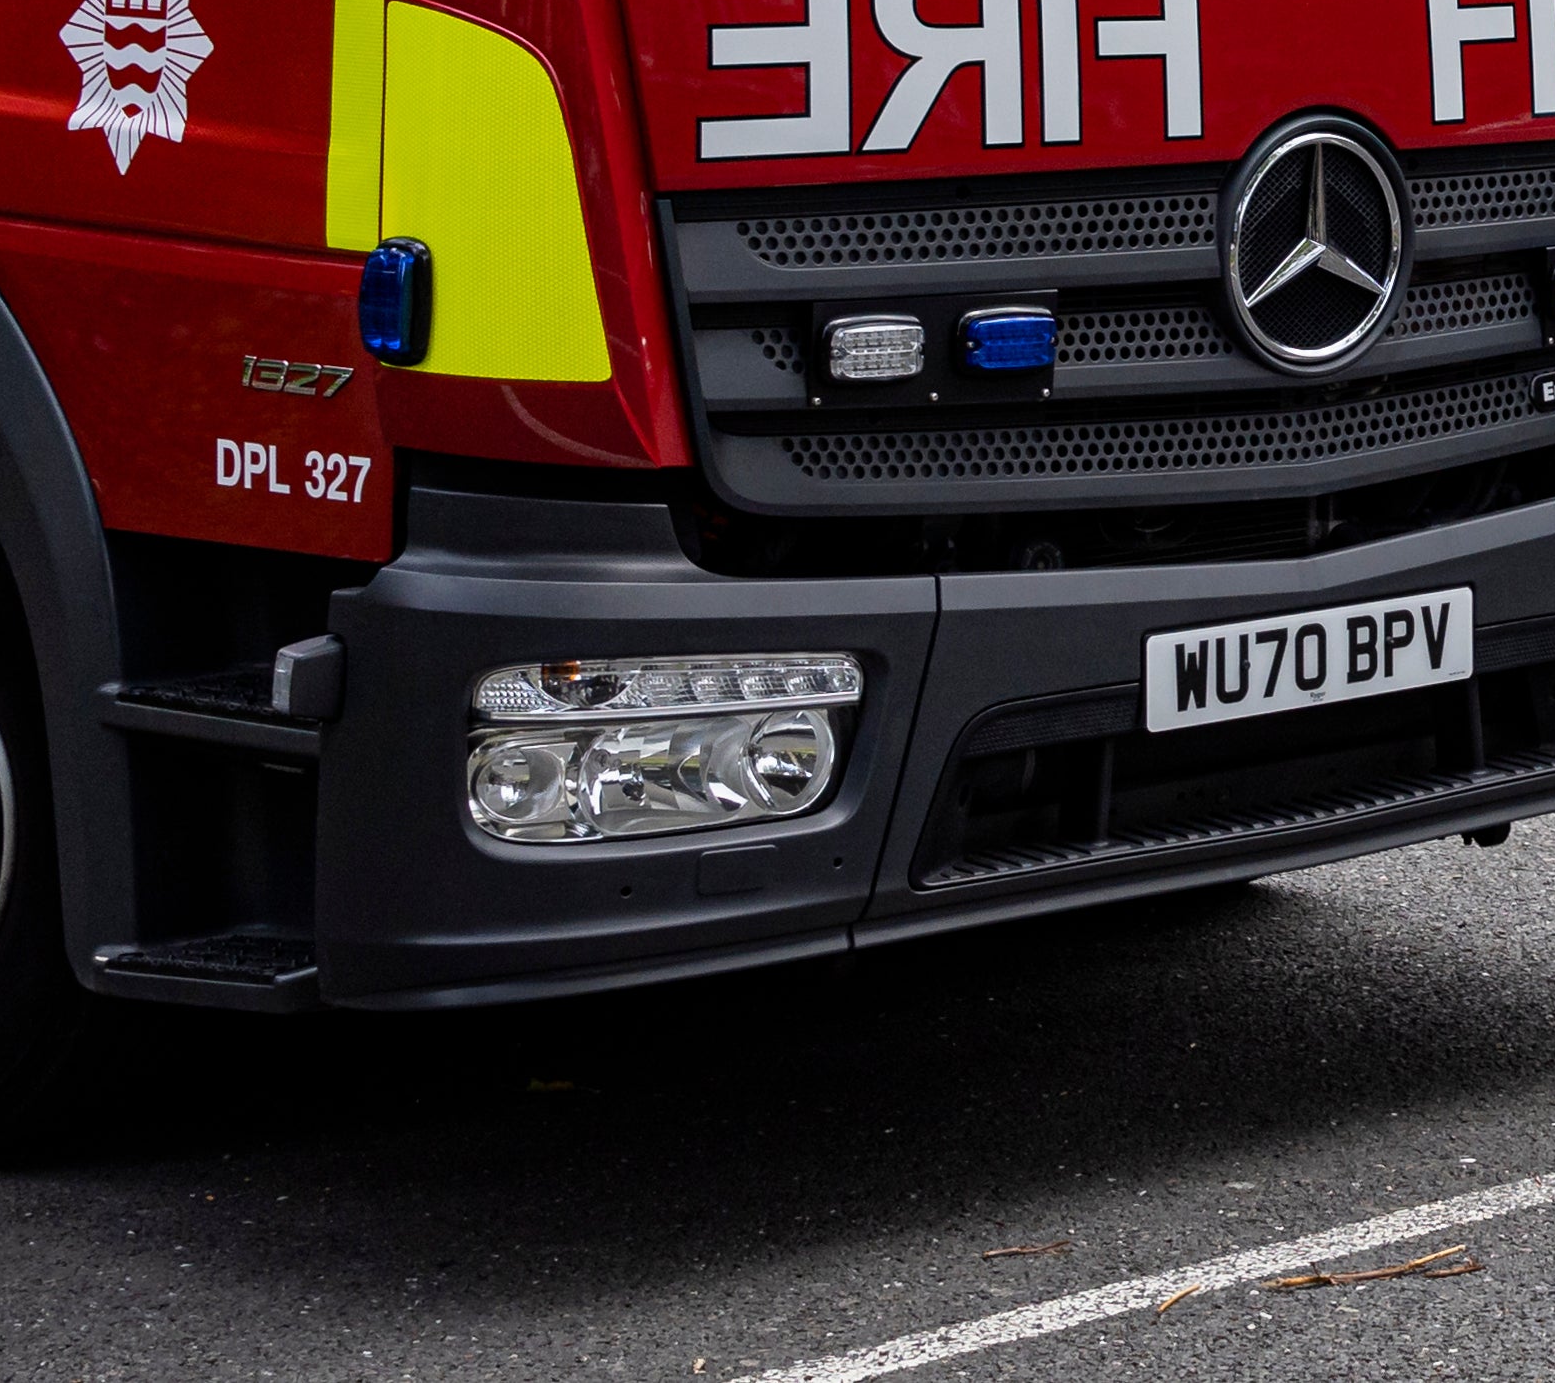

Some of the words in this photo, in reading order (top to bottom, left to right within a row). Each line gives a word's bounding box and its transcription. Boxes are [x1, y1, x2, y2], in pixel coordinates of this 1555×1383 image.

[242, 355, 355, 398] 1327
[216, 438, 292, 495] DPL
[304, 450, 372, 504] 327
[1174, 622, 1328, 713] WU70
[1347, 601, 1451, 685] BPV
